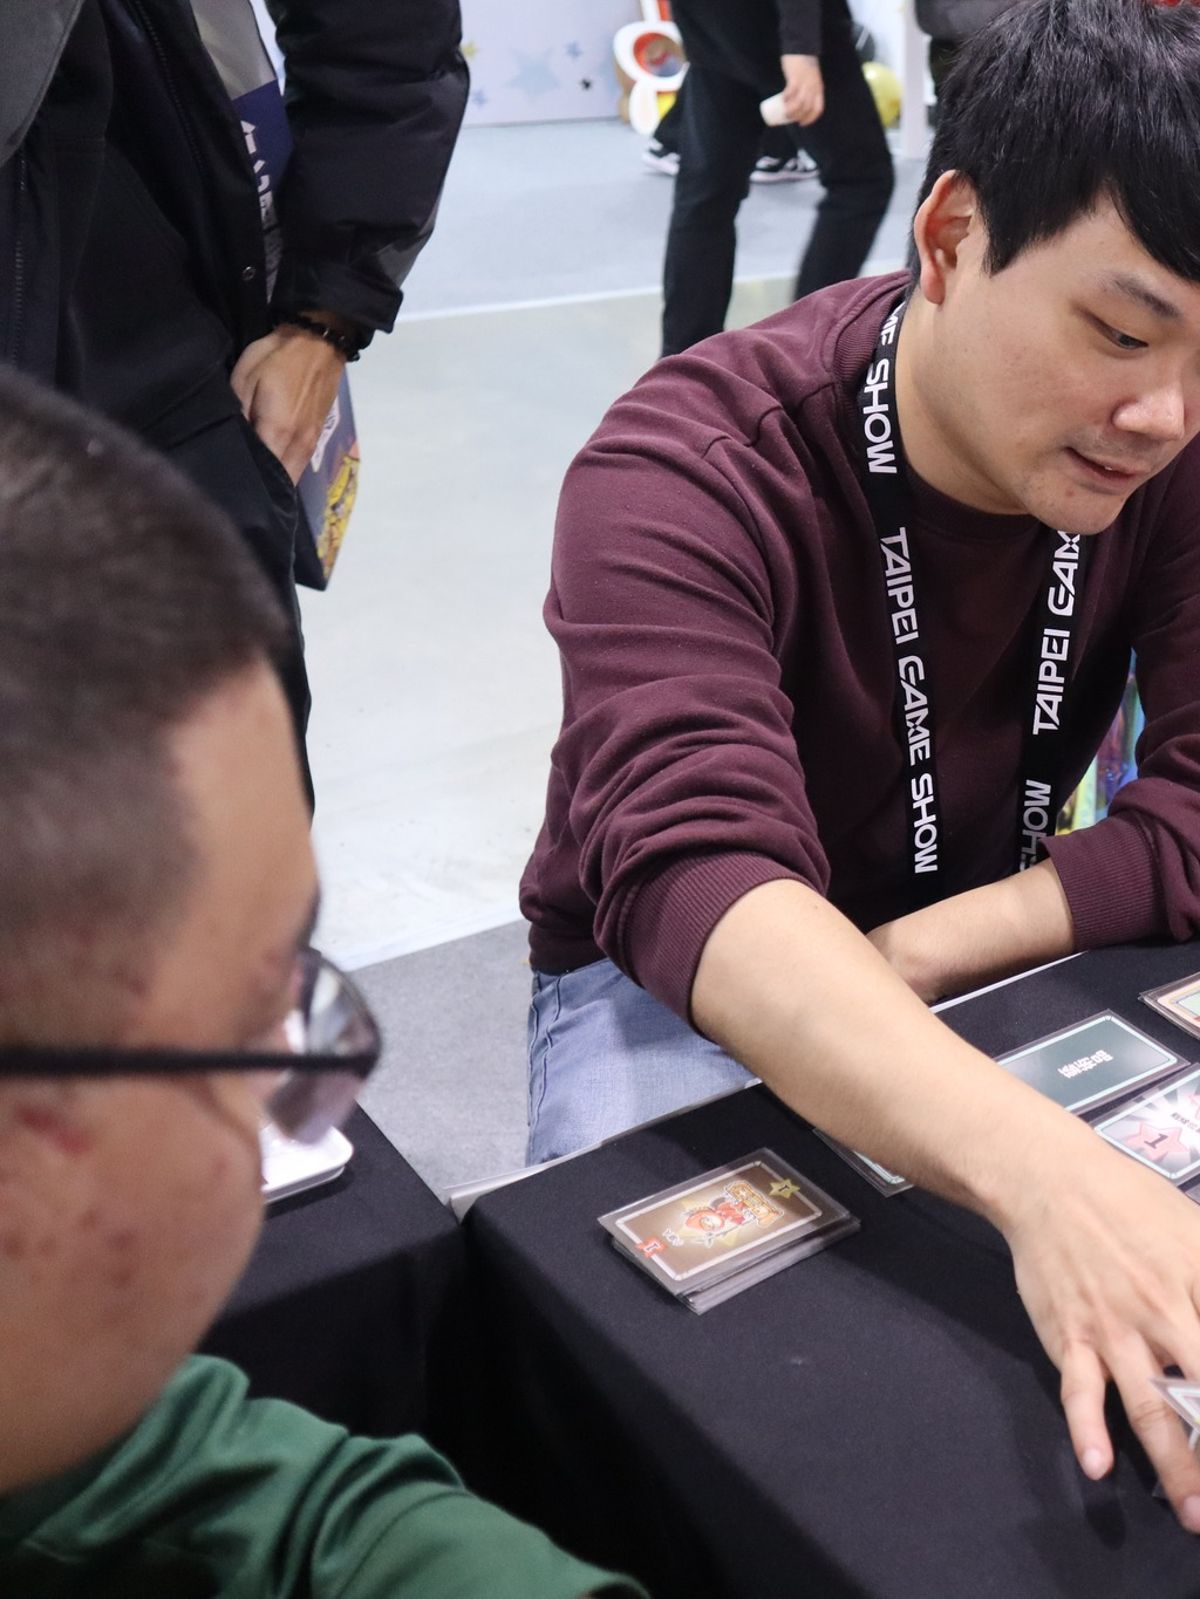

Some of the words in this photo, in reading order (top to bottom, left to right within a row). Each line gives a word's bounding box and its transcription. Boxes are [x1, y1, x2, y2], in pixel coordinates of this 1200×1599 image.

[863, 358, 898, 474] SHOW
[880, 526, 919, 645] TAIPEI
[898, 654, 931, 767] GAME
[1032, 628, 1071, 735] TAIPEI
[910, 777, 938, 874] SHOW
[1143, 1133, 1168, 1149] 1
